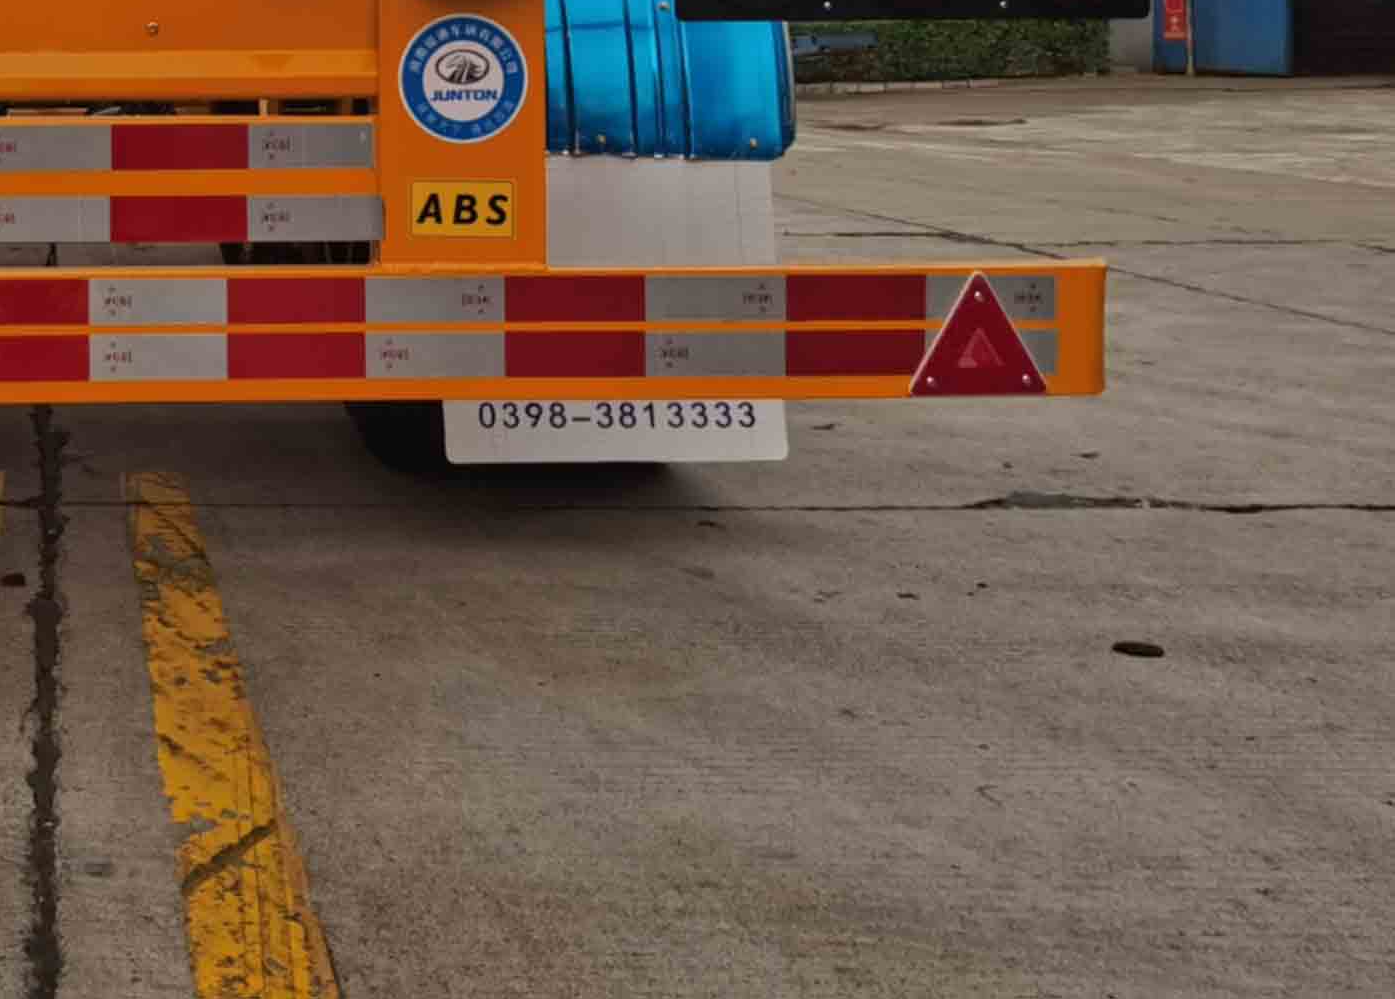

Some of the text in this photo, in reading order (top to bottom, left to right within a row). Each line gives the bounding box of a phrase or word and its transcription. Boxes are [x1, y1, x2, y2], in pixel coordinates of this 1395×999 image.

[430, 89, 498, 101] JUNTON
[416, 193, 509, 226] ABS
[478, 401, 757, 429] 0398-3813333
